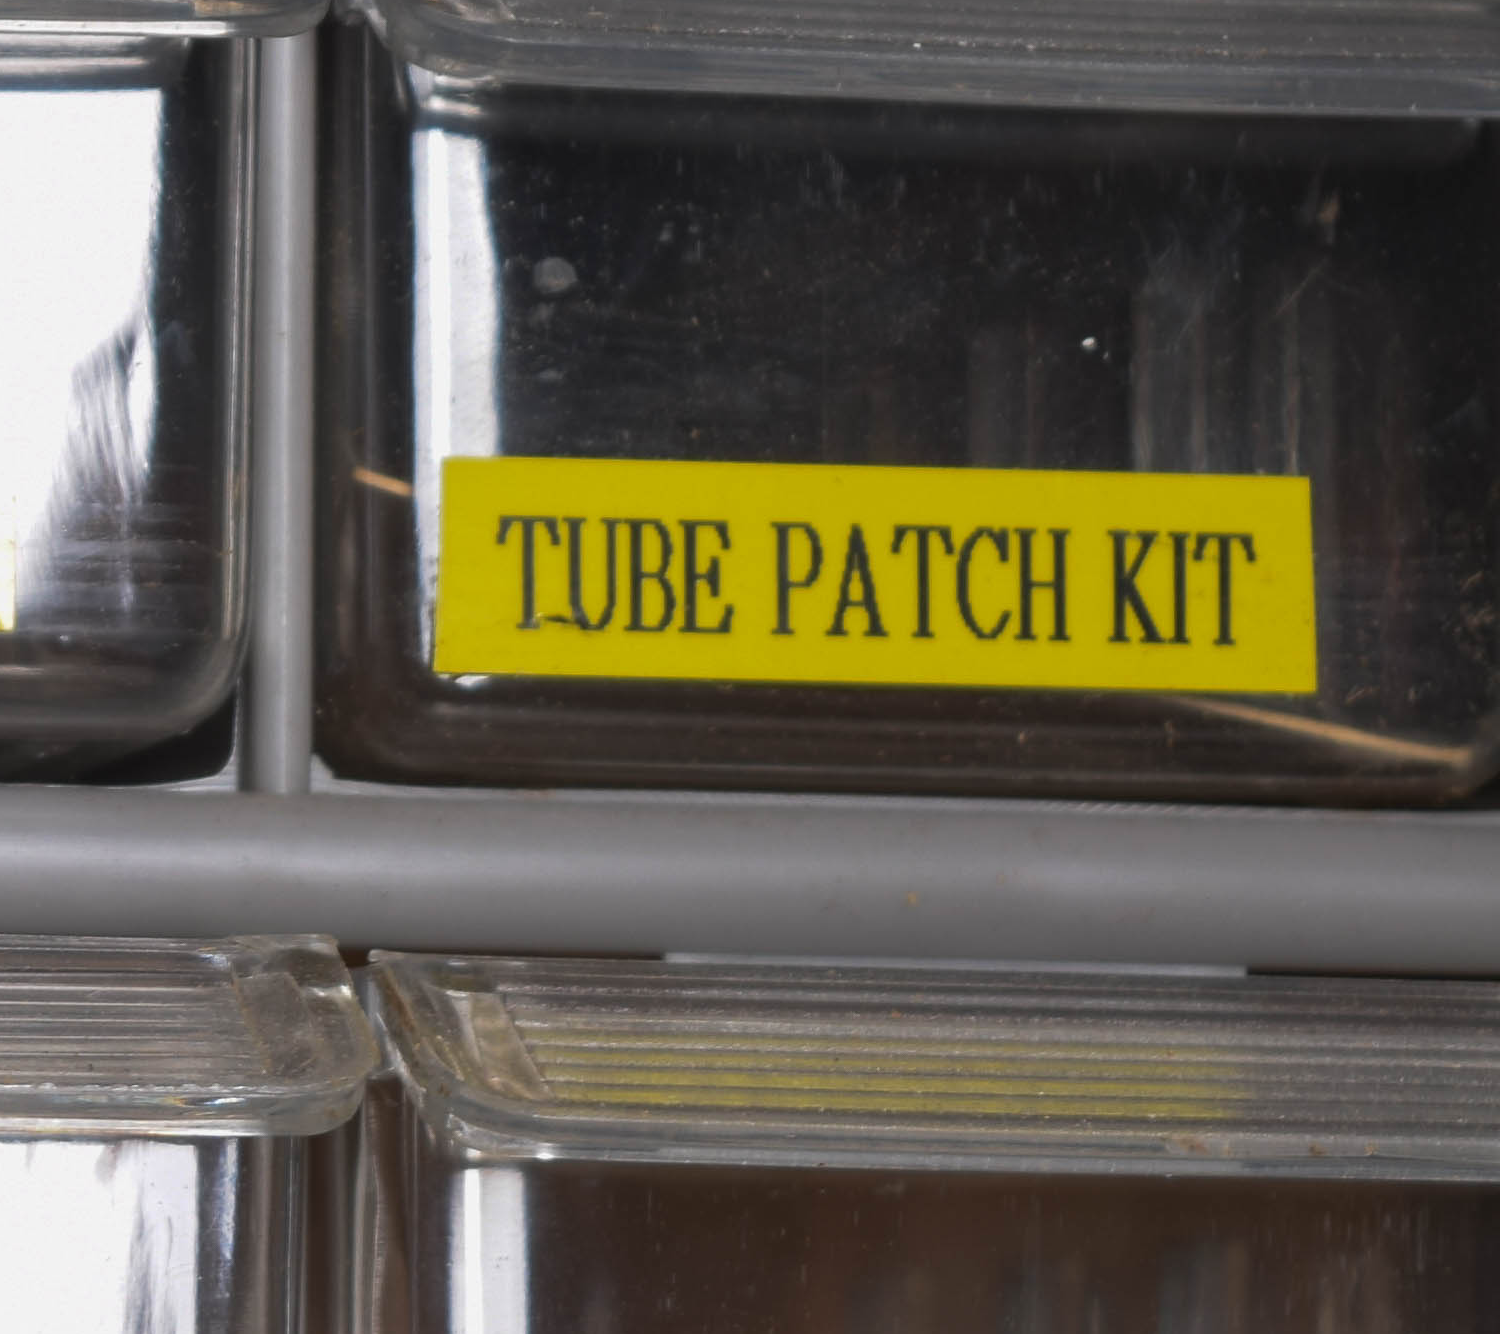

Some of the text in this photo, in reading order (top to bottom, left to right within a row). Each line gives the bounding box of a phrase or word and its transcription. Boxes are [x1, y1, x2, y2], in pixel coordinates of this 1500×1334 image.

[496, 514, 1257, 646] TUBE PATCH KIT
